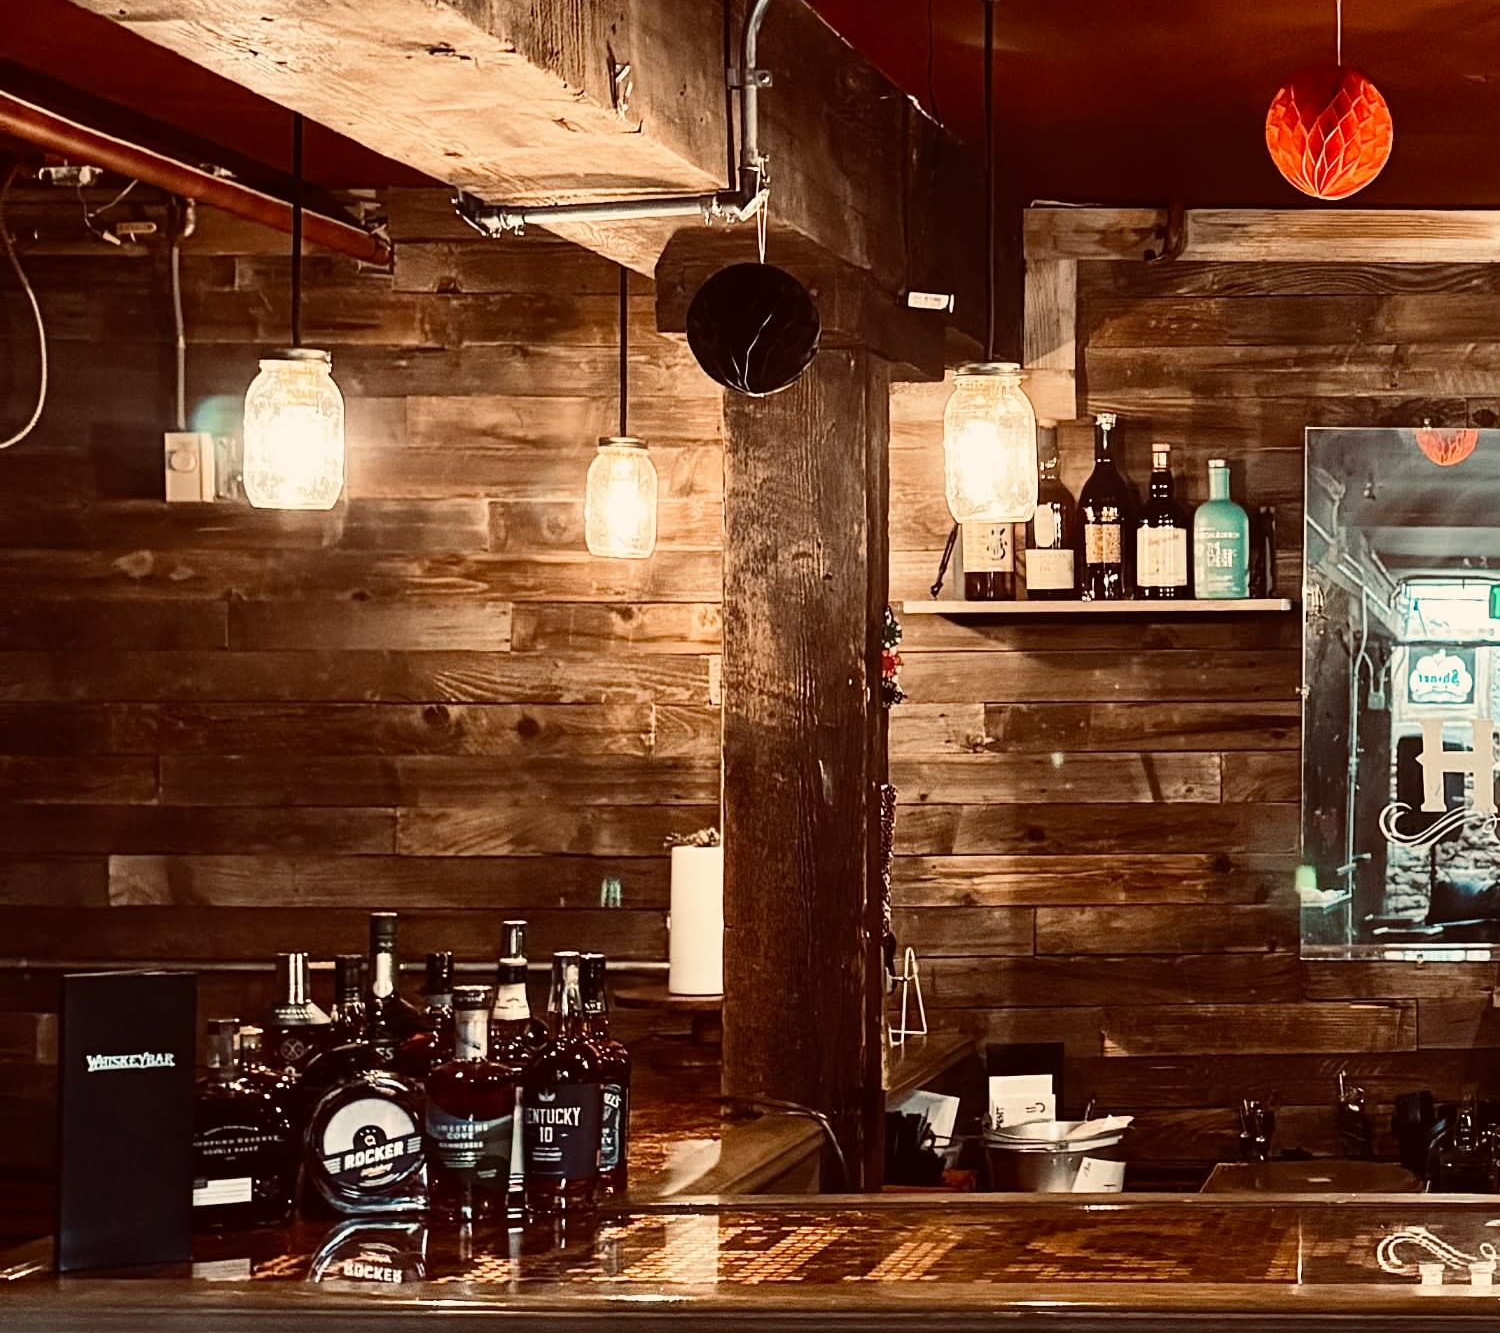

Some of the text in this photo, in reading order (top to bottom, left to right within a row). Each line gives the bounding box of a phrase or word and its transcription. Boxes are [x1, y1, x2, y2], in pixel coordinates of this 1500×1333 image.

[526, 1107, 581, 1127] ENTUCKY
[539, 1126, 553, 1143] 10
[343, 1141, 405, 1171] ROCKER
